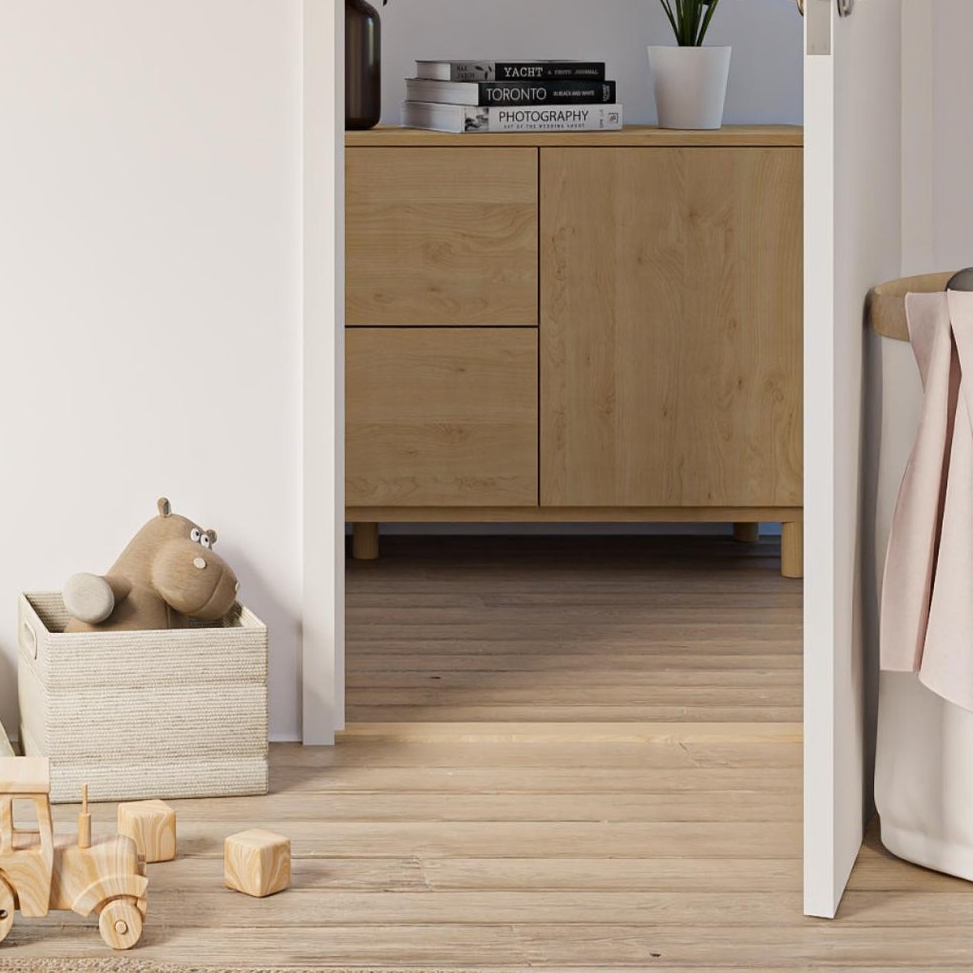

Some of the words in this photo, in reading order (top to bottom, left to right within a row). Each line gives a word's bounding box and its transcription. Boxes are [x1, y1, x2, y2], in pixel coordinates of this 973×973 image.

[504, 67, 544, 77] YACHT
[486, 87, 547, 101] TORONTO
[498, 110, 589, 123] PHOTOGRAPHY
